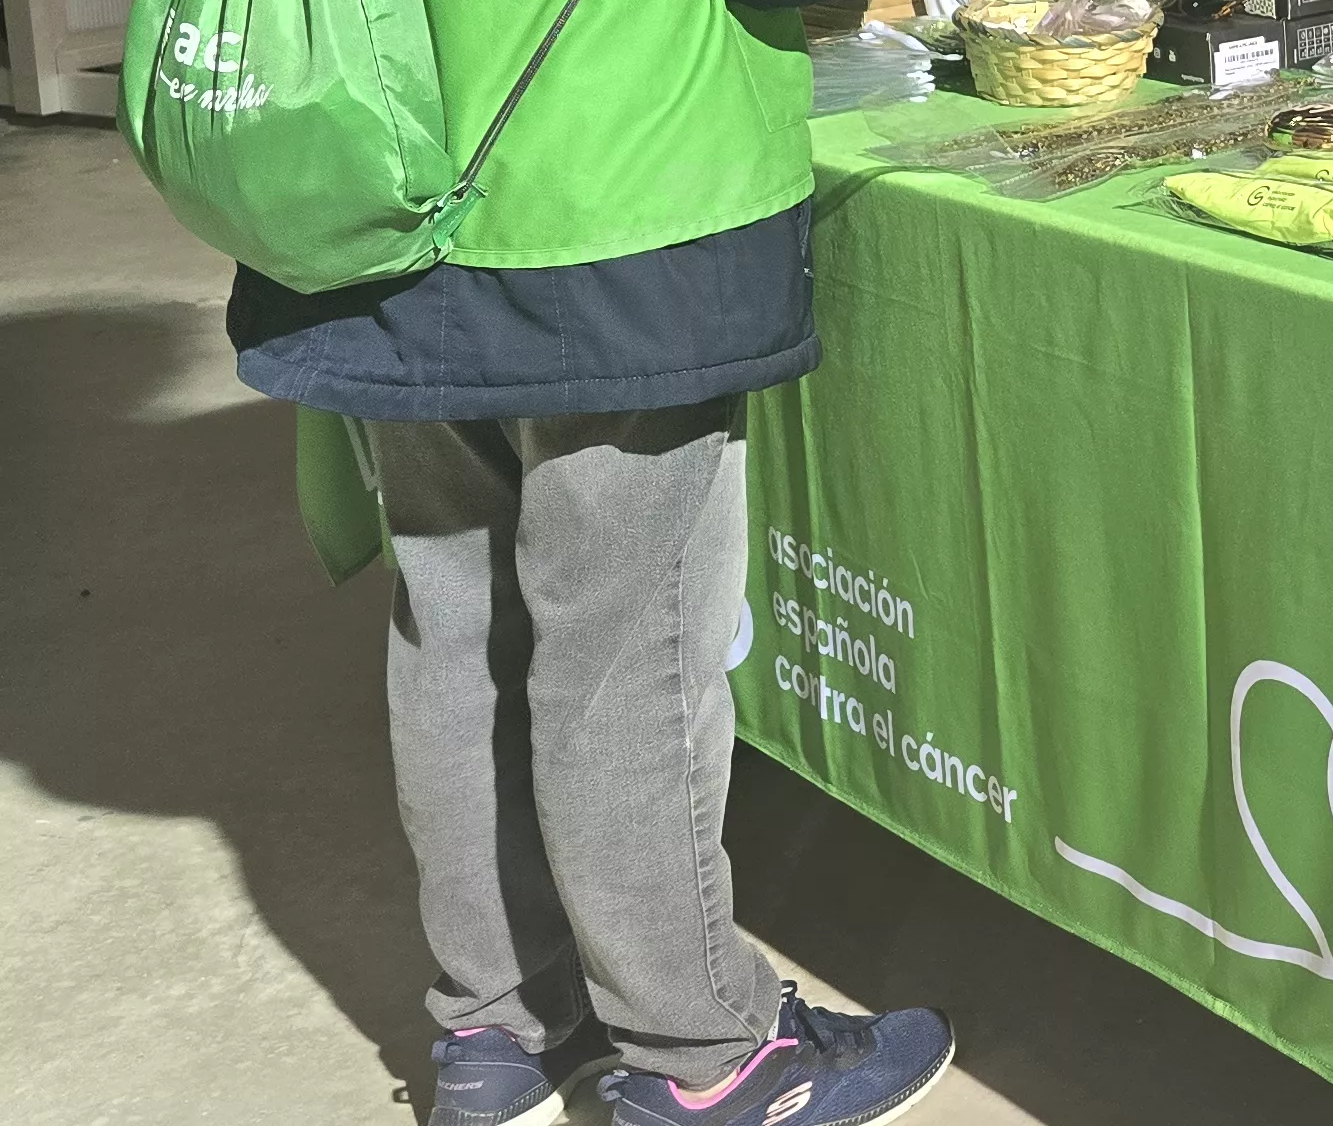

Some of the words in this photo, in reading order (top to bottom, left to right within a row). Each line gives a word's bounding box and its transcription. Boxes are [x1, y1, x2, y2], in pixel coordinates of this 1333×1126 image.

[767, 525, 916, 639] asociación
[772, 591, 897, 694] española
[775, 654, 867, 737] contra
[872, 710, 896, 758] el
[901, 731, 1018, 823] cáncer
